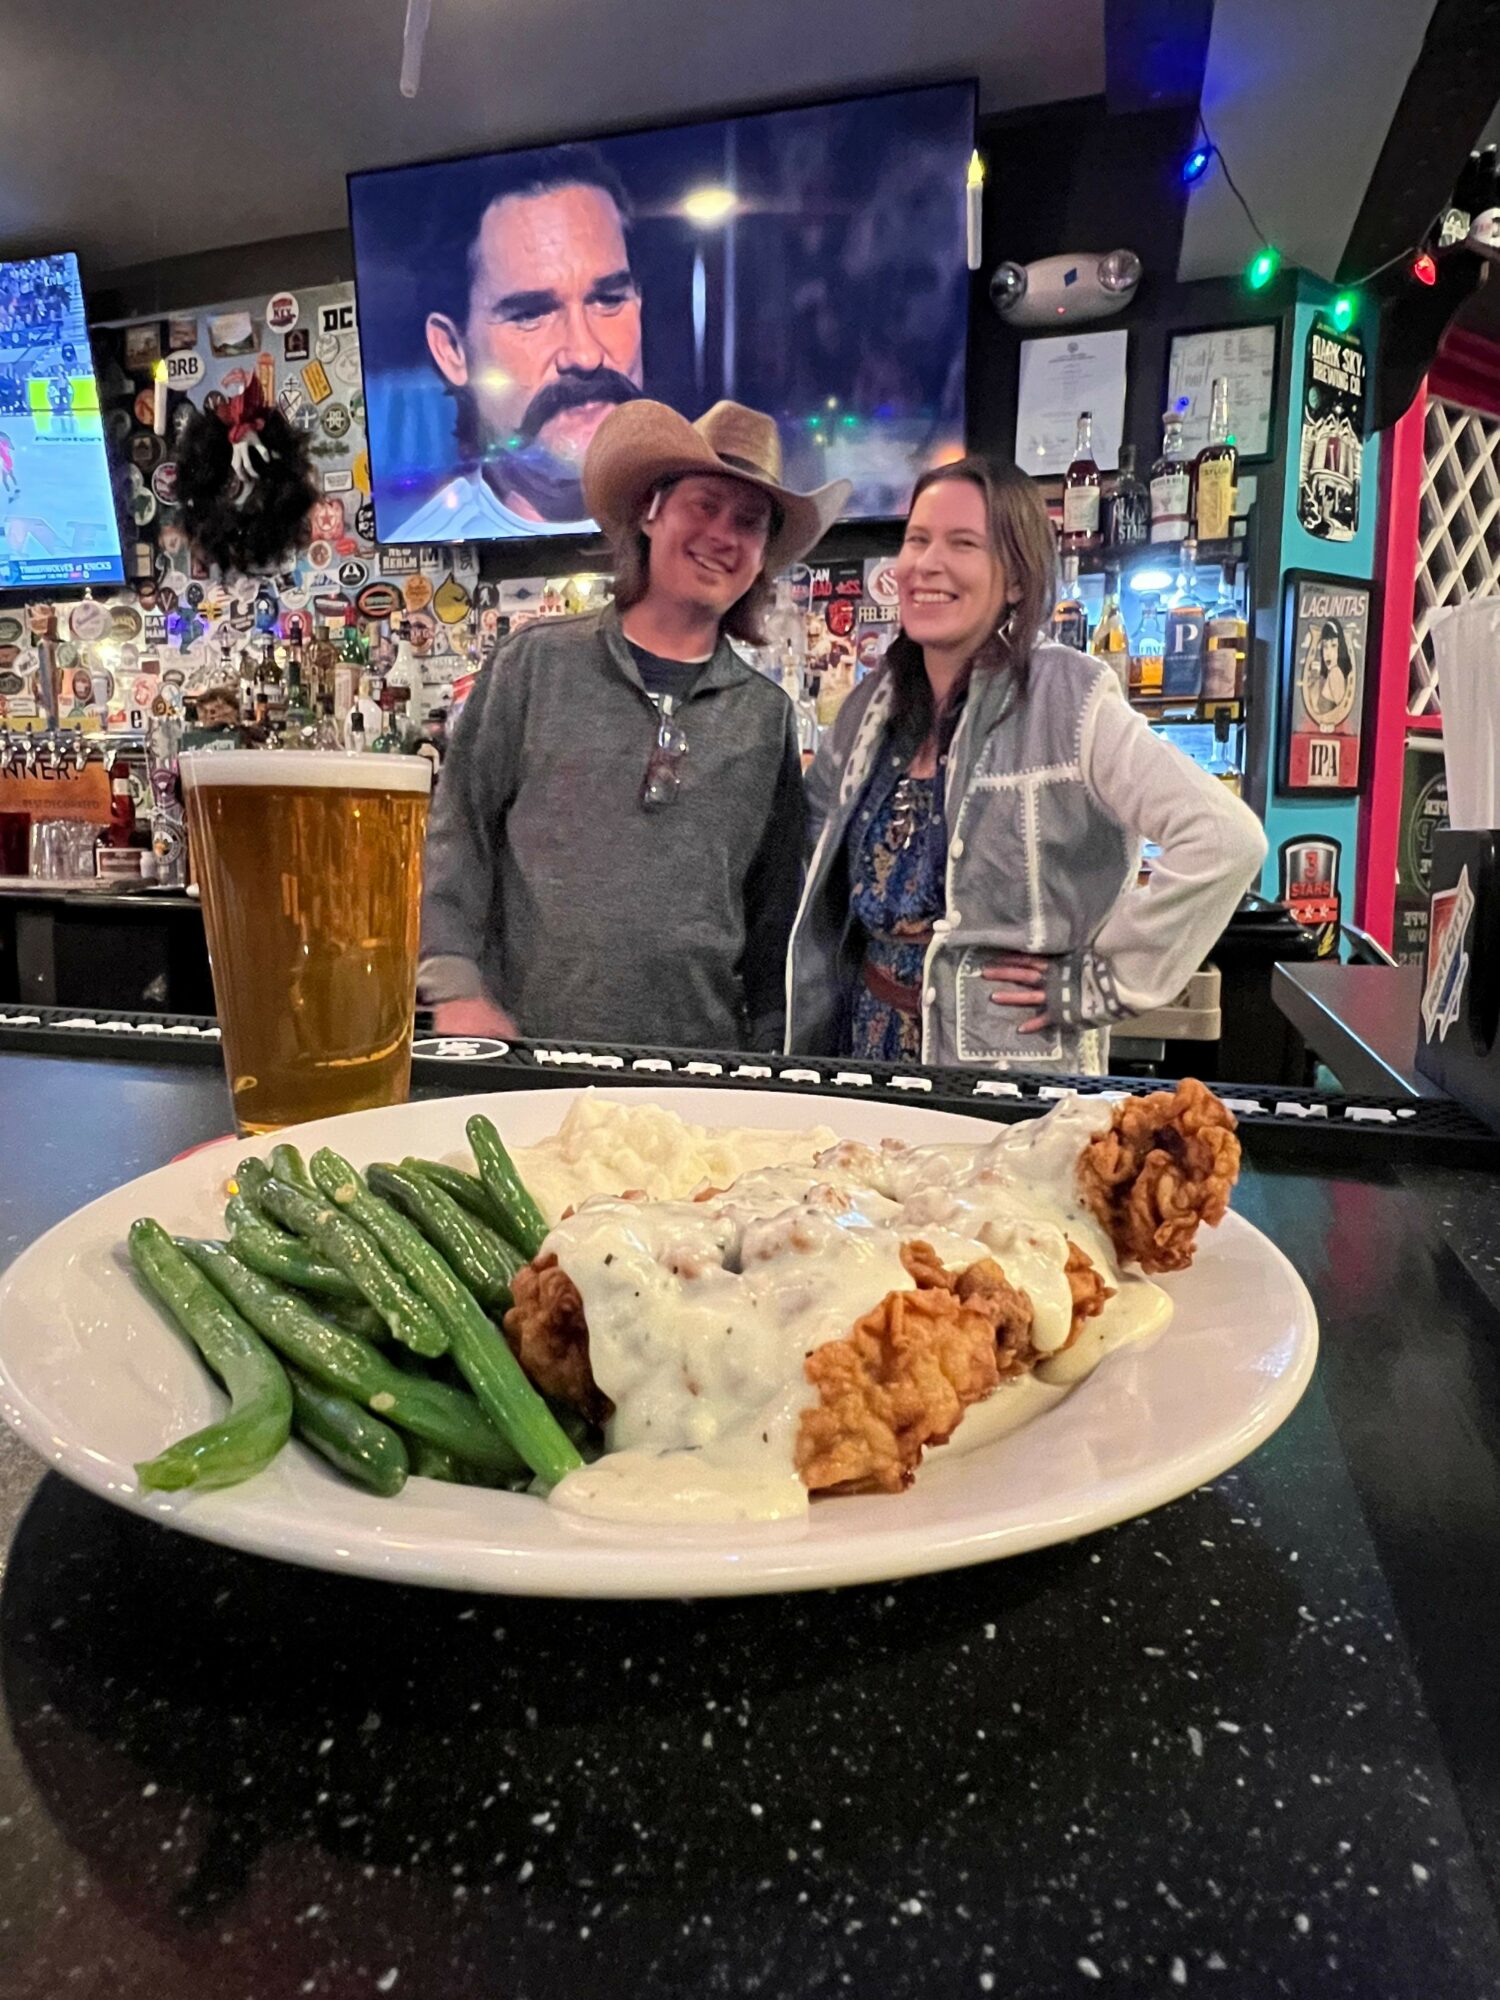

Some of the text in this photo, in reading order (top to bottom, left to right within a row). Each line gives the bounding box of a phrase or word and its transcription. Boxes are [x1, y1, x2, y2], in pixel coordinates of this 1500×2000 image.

[323, 305, 353, 332] DC
[168, 357, 199, 377] BRB
[1312, 335, 1363, 377] DARK SKY
[1313, 360, 1348, 391] BREWING
[1300, 595, 1365, 618] LAGUNITAS
[1175, 623, 1199, 653] P
[1311, 744, 1338, 777] IPA
[1305, 851, 1318, 880] 3
[1291, 882, 1330, 897] STARS
